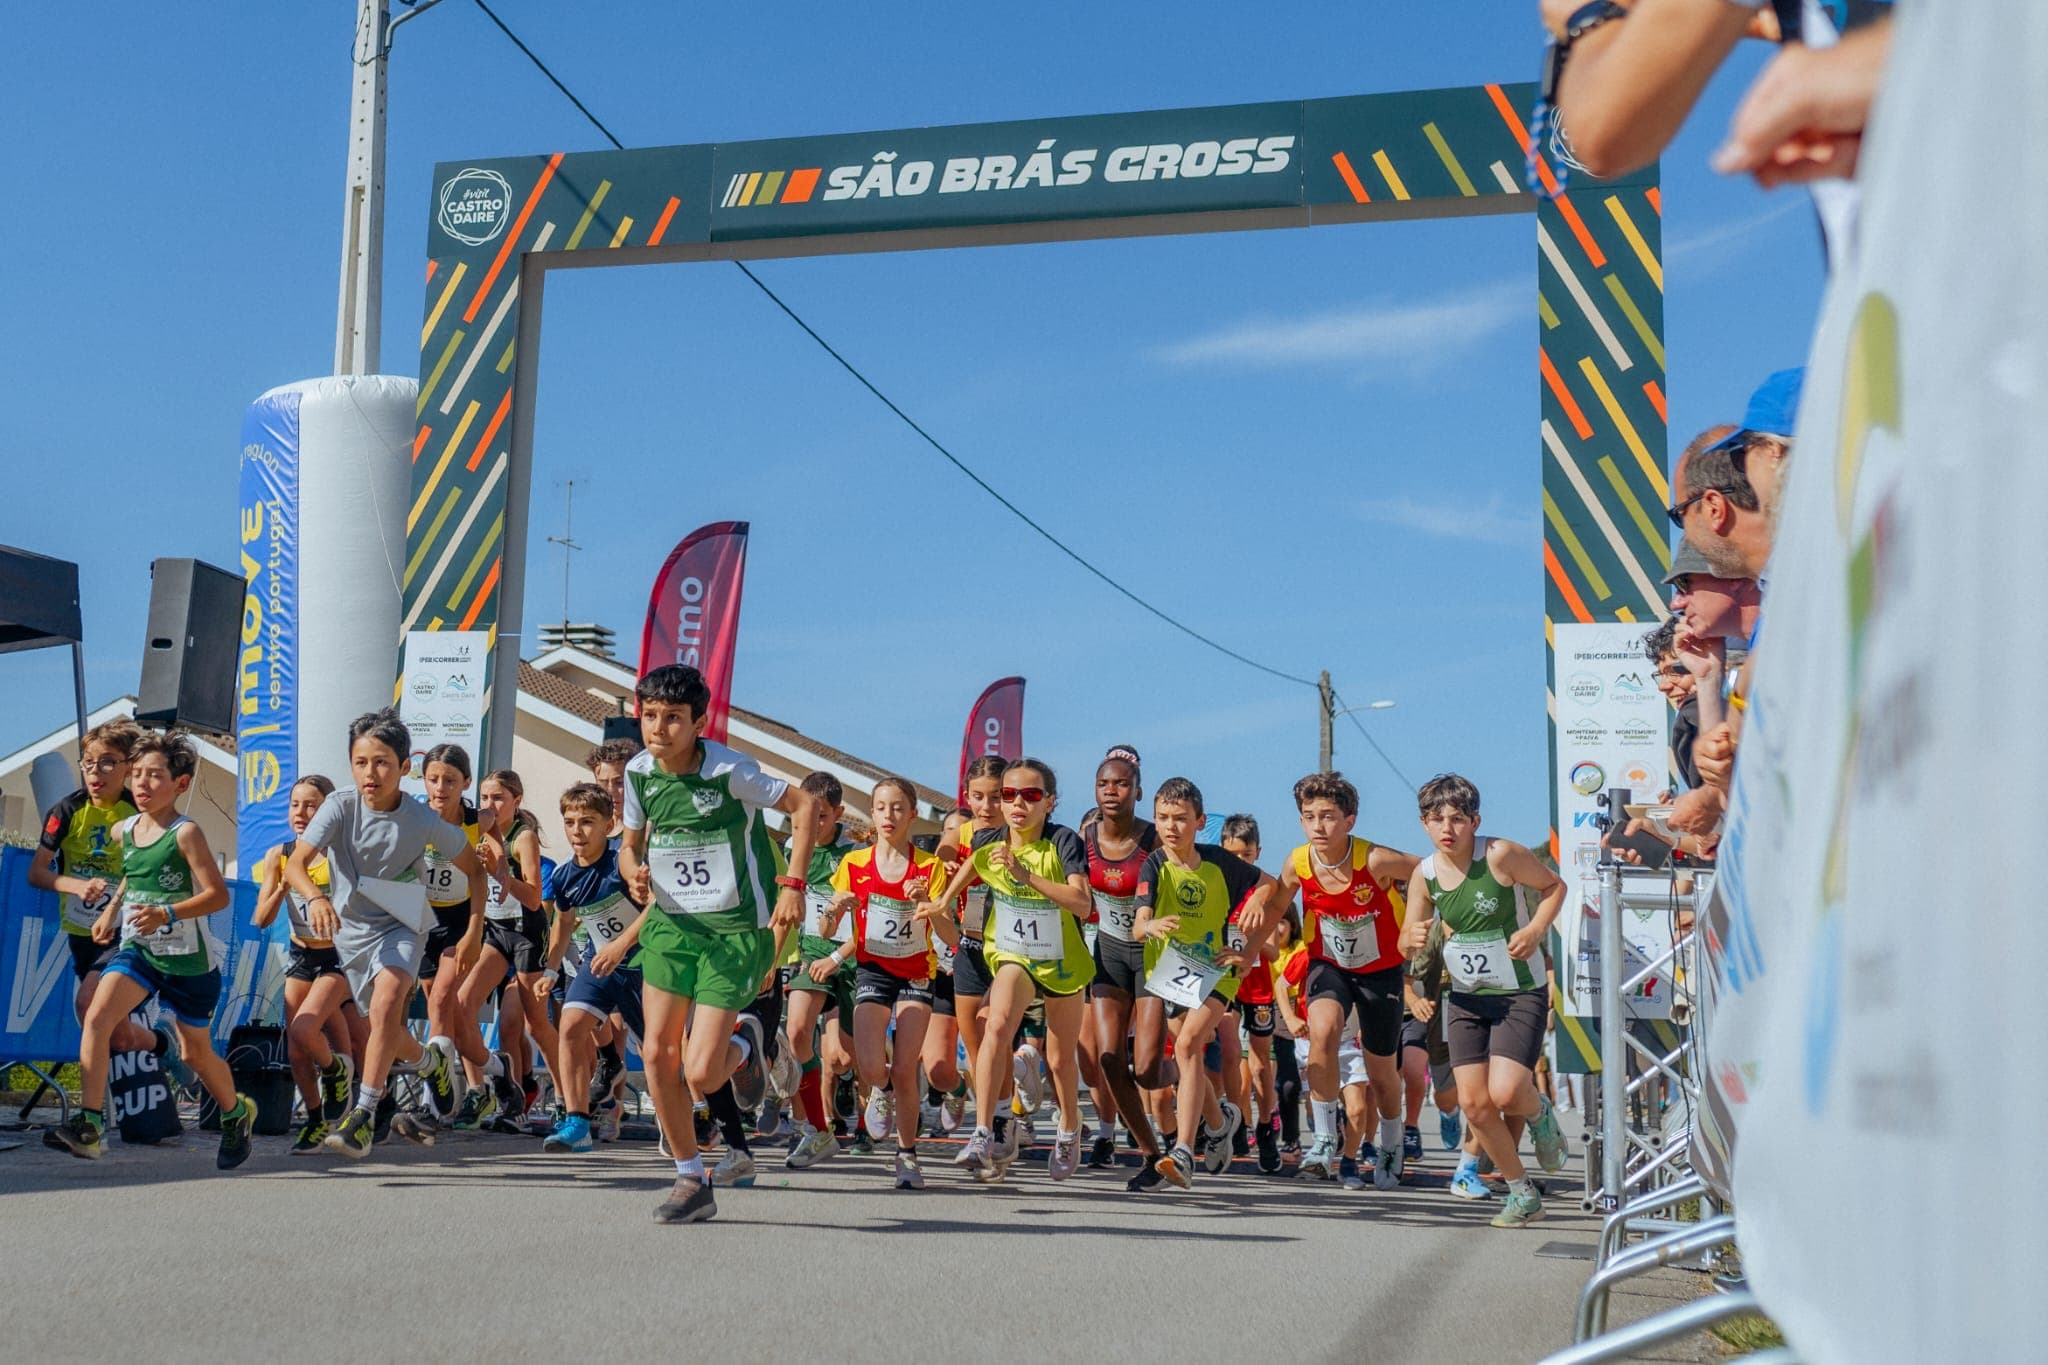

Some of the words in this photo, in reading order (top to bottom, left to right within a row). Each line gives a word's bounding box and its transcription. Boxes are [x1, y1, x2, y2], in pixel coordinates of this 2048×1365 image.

[822, 151, 934, 200] SÃO
[938, 139, 1097, 193] BRÁS
[1104, 136, 1295, 183] CROSS
[447, 199, 503, 213] CASTRO
[453, 211, 496, 224] DAIRE
[267, 498, 284, 614] portugal
[268, 625, 281, 710] centro
[426, 868, 452, 887] 18
[674, 860, 710, 887] 35
[596, 917, 624, 939] 66
[884, 919, 912, 939] 24
[1013, 918, 1039, 940] 41
[1110, 910, 1133, 928] 53
[1334, 935, 1358, 954] 67
[1460, 954, 1491, 975] 32
[1172, 966, 1205, 989] 27
